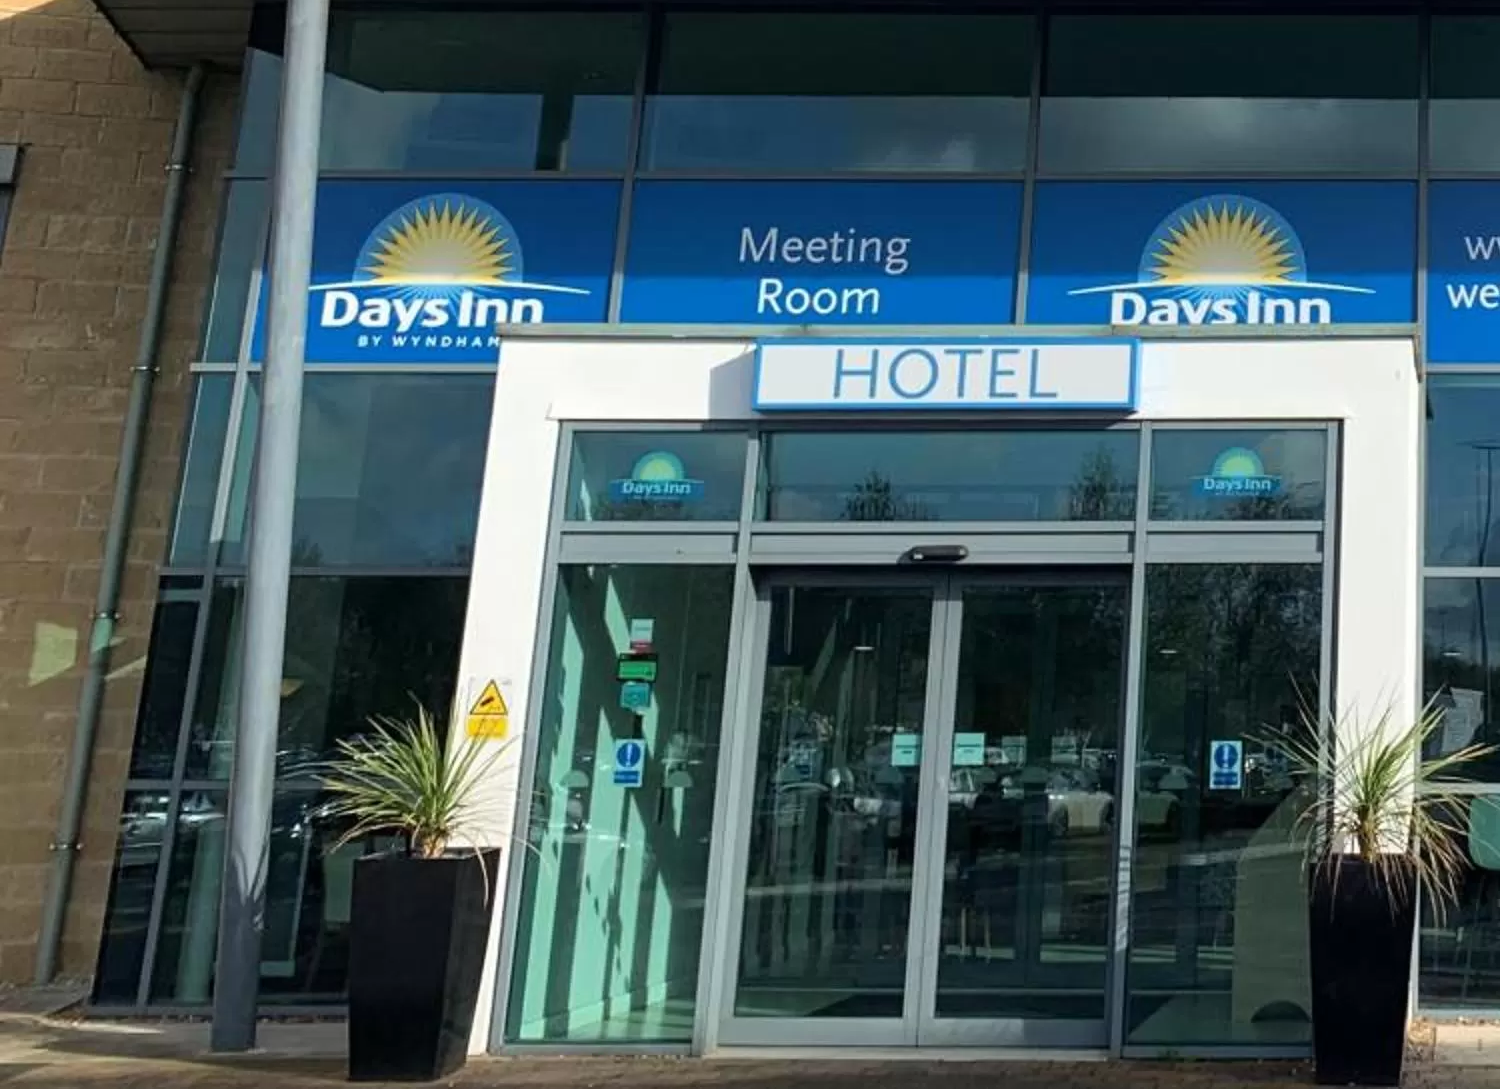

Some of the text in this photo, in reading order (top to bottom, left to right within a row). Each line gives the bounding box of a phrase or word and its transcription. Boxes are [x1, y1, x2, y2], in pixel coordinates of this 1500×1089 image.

[738, 226, 912, 275] Meeting
[320, 290, 544, 333] Days Inn
[756, 277, 880, 315] Room
[1110, 290, 1332, 326] Days Inn
[357, 335, 501, 348] BY WYNDHAM
[832, 348, 1058, 399] HOTEL
[623, 482, 691, 495] Days Inn
[1203, 477, 1271, 492] Days Inn
